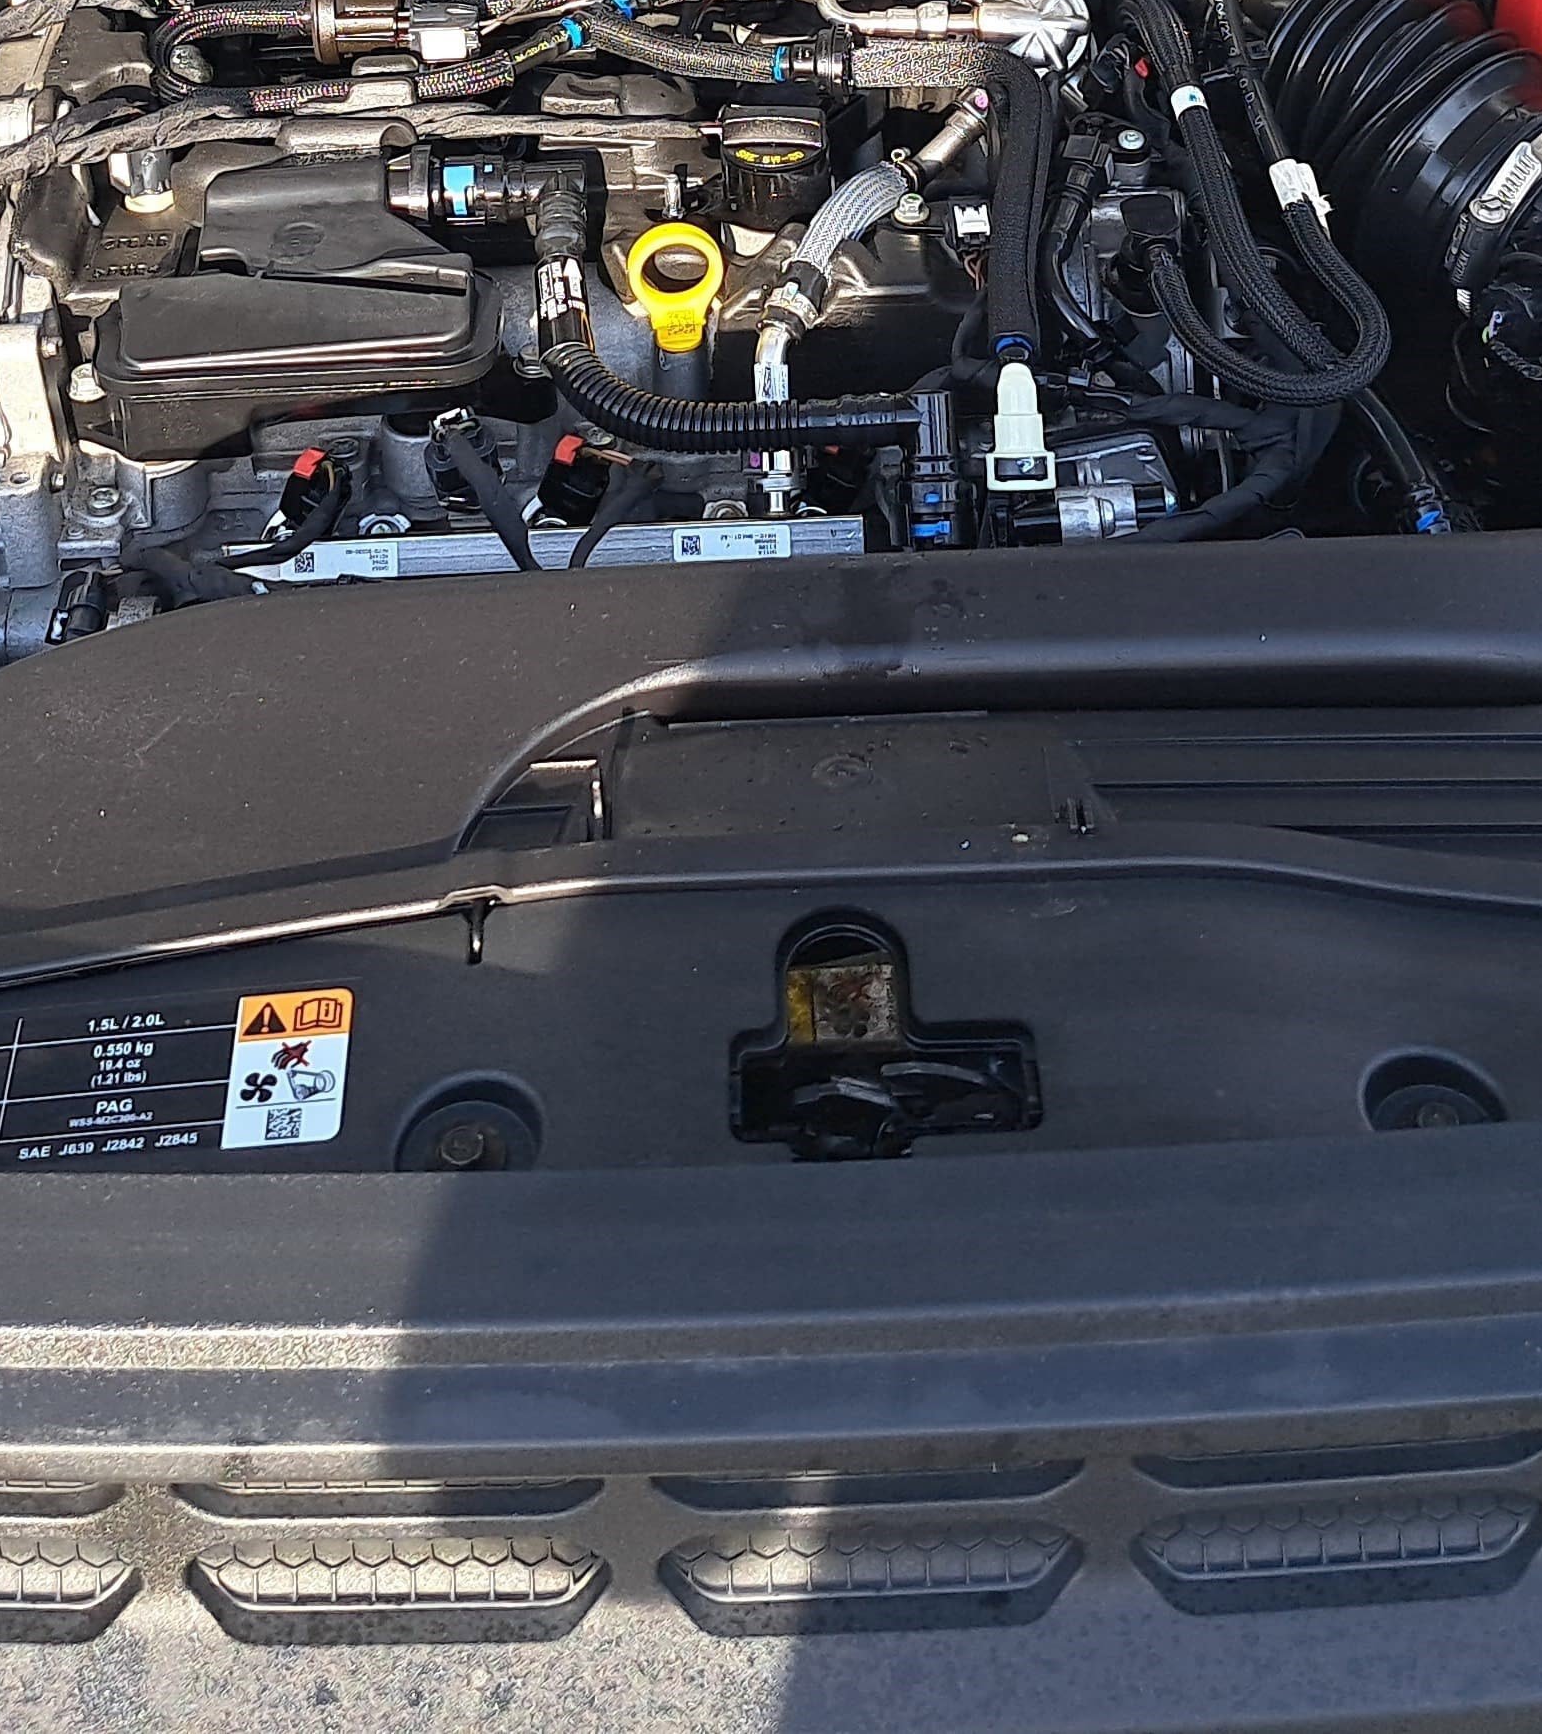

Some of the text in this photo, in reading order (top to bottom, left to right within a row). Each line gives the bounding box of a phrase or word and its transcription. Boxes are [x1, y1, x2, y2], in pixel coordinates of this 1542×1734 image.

[88, 1013, 165, 1033] 1.5L / 2.0L
[93, 1041, 154, 1058] 0.550 kg
[99, 1058, 141, 1070] 19.4 oz
[91, 1070, 147, 1088] (1.21 lbs)
[95, 1098, 133, 1115] PAG
[18, 1132, 198, 1160] SAE J639 J2842 J2845
